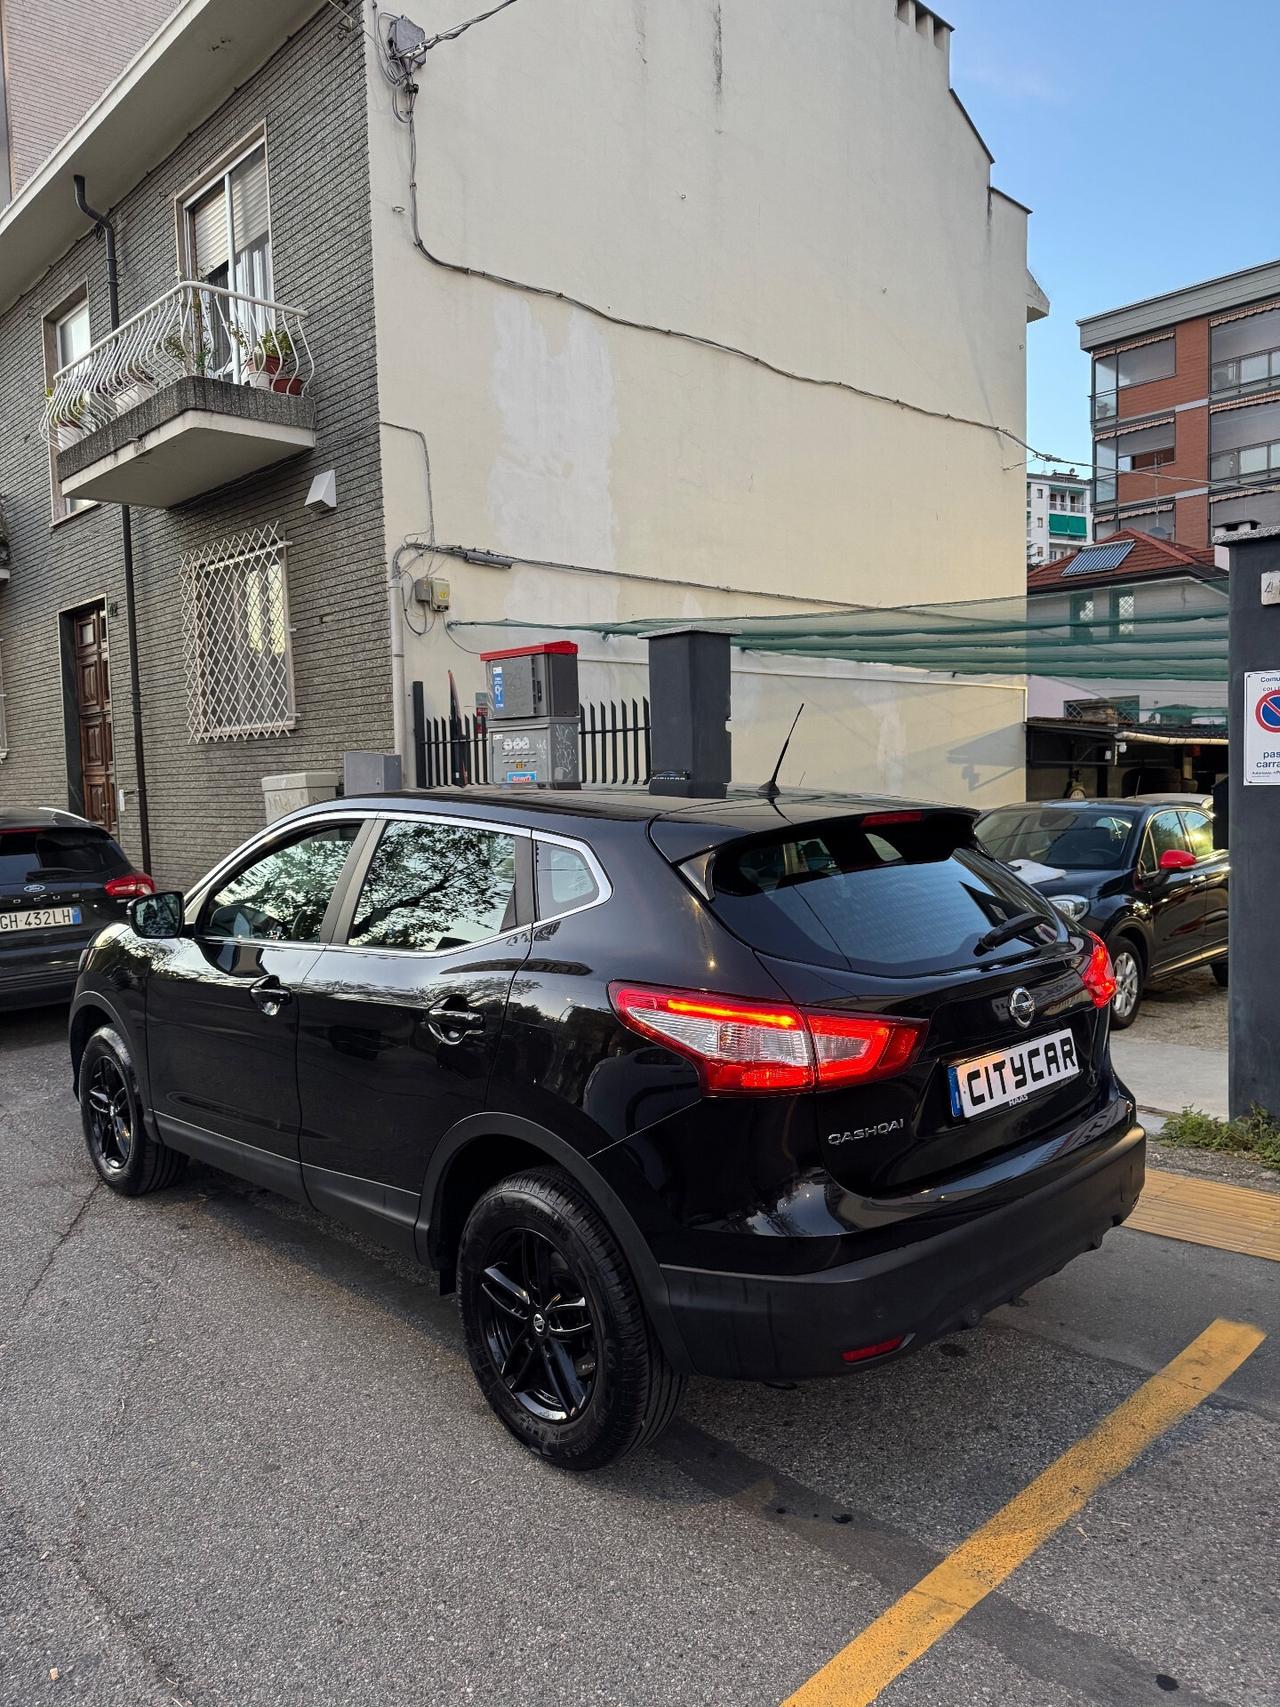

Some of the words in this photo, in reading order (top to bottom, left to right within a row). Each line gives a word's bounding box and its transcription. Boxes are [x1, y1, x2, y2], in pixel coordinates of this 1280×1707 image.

[24, 908, 71, 927] 432LH
[966, 1036, 1076, 1107] CITYCAR
[827, 1118, 904, 1146] QASHQAI
